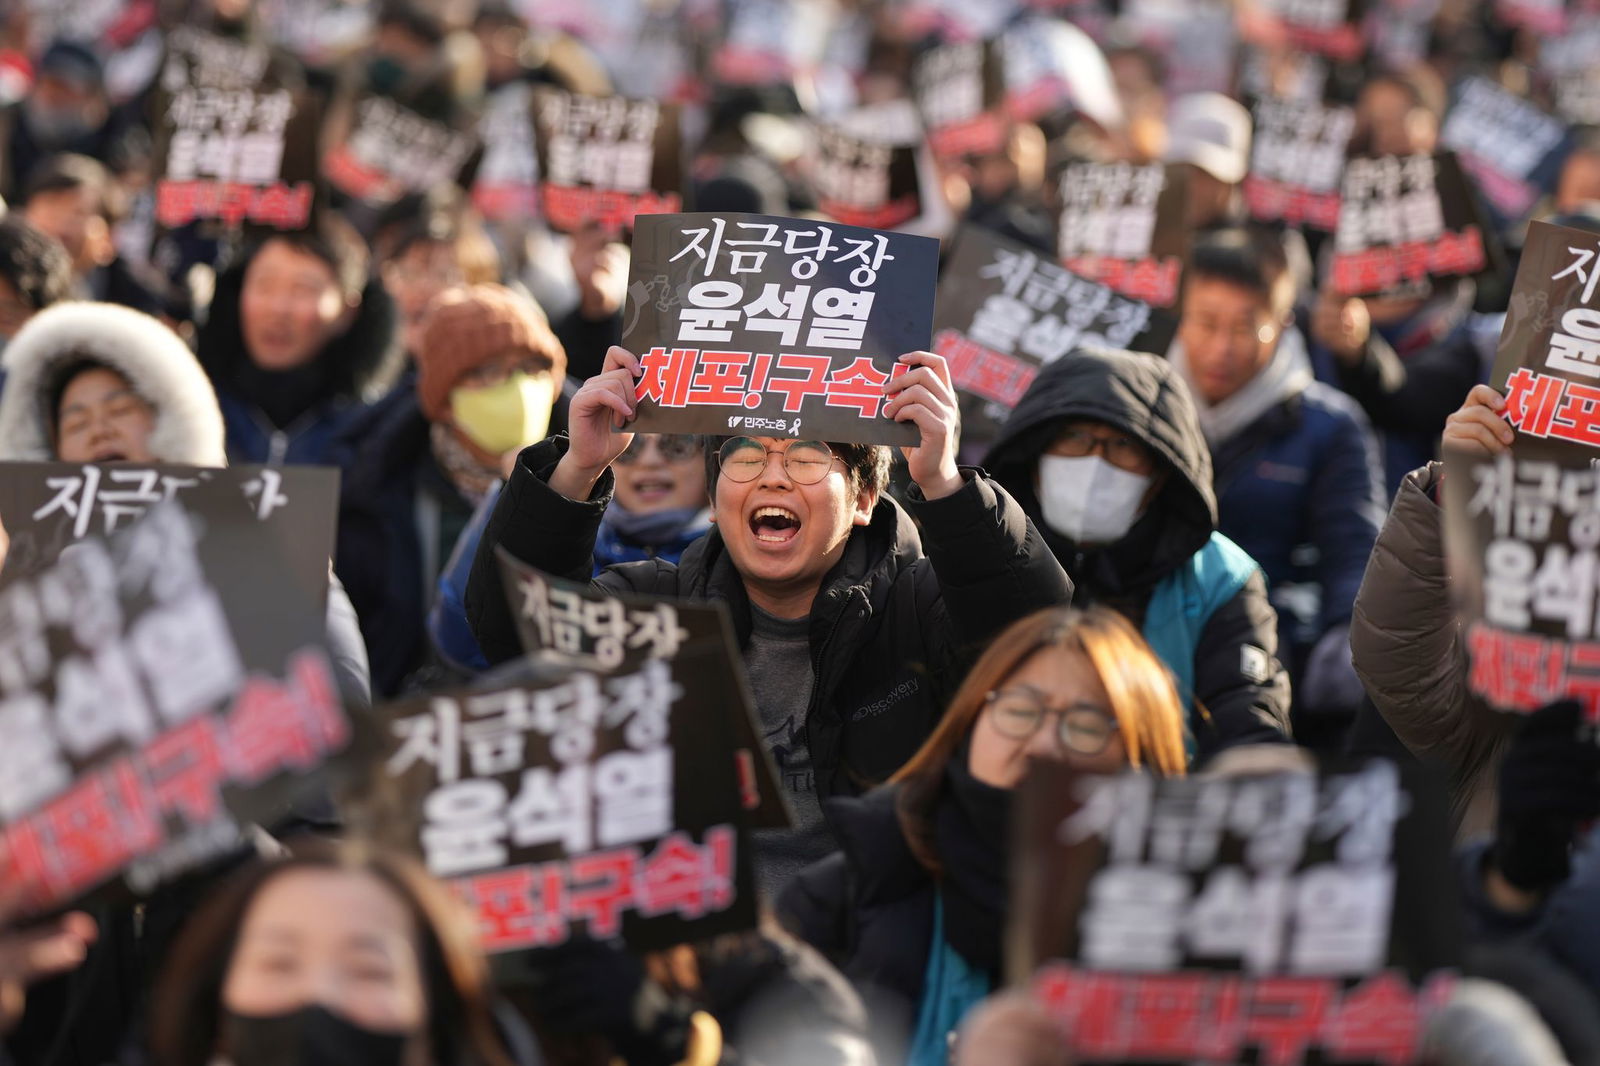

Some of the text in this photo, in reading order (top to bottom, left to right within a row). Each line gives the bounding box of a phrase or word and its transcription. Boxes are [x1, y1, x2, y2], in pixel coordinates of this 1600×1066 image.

[669, 217, 895, 287] 지금당장
[677, 280, 876, 350] 윤석열
[743, 416, 787, 431] 민주노총
[385, 656, 685, 784] 지금당장
[852, 677, 919, 721] Discovery
[420, 746, 676, 878] 윤석열
[450, 824, 738, 957] 포!구속!
